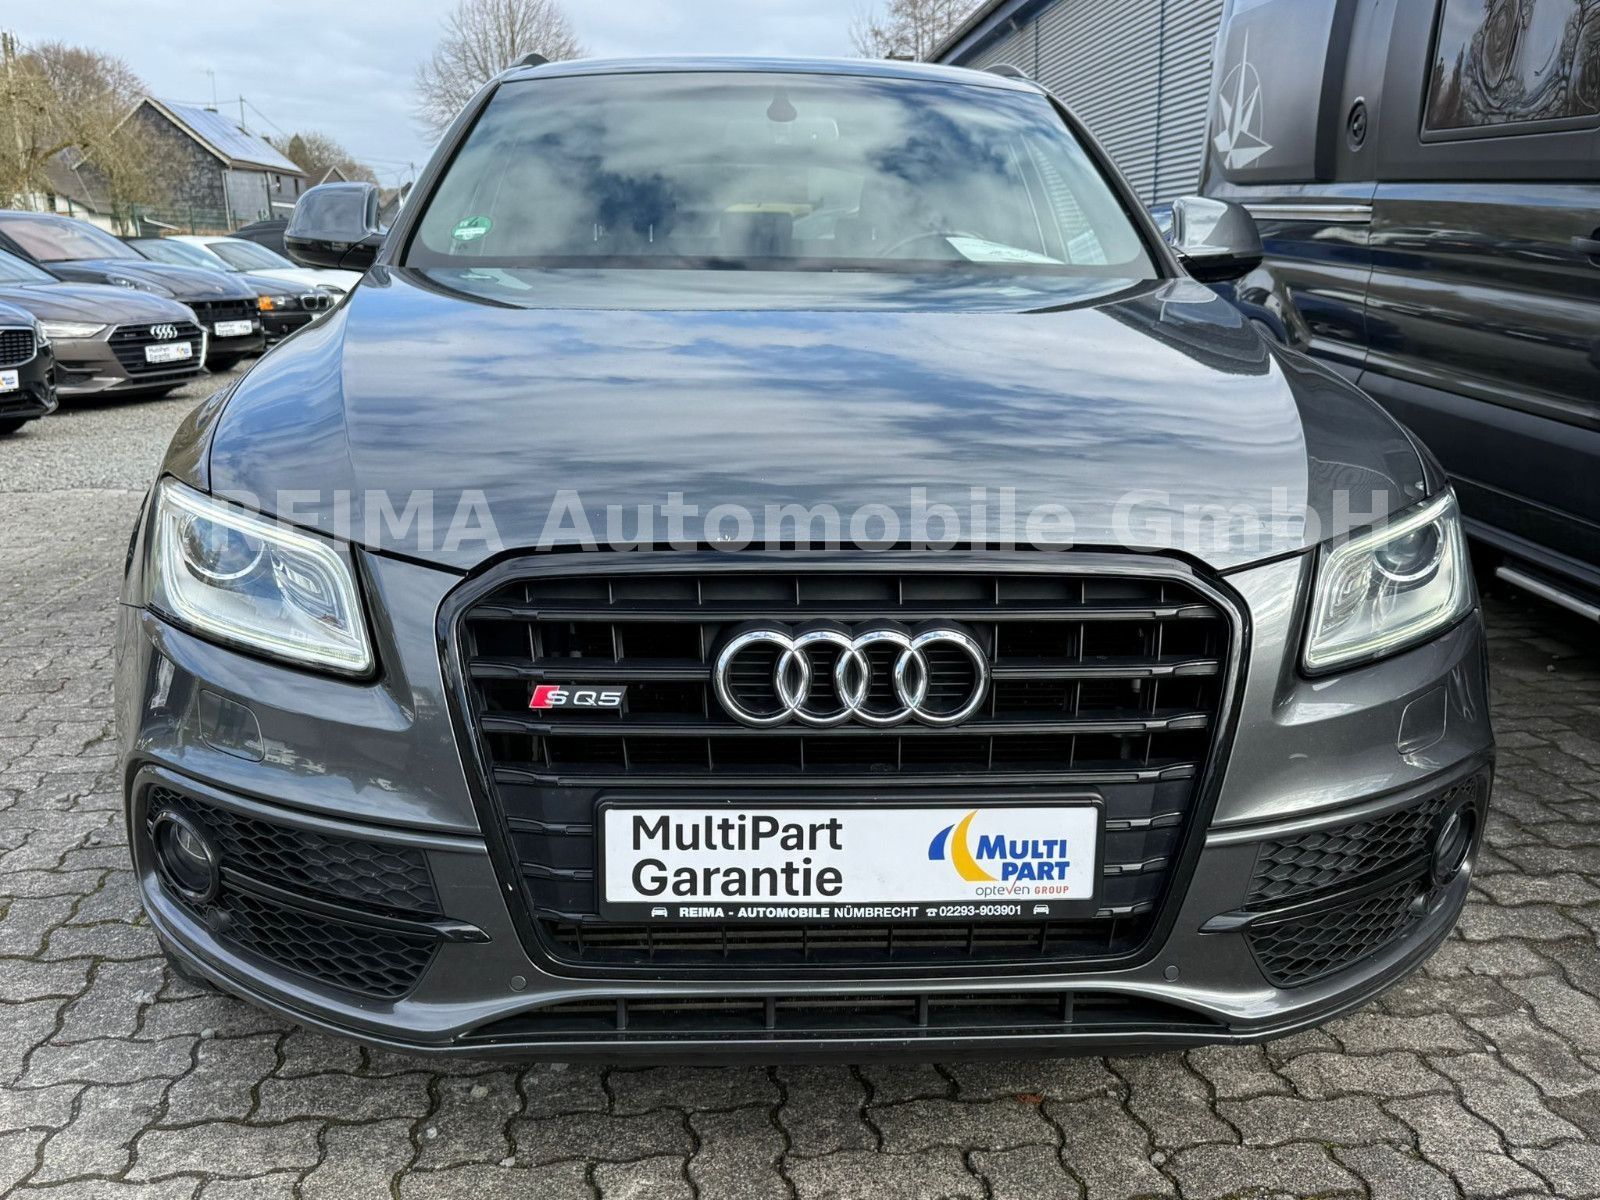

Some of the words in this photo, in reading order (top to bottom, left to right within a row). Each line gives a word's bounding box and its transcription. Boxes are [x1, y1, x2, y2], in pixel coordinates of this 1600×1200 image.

[632, 814, 843, 851] MultiPart
[632, 857, 843, 897] Garantie
[1001, 861, 1070, 882] PART
[976, 879, 1030, 897] opteven
[1034, 885, 1069, 895] GROUP
[679, 906, 725, 918] REIMA
[737, 906, 830, 918] AUTOMOBILE
[834, 904, 919, 918] NÜMBRECHT
[939, 904, 1021, 917] 02293-903901
